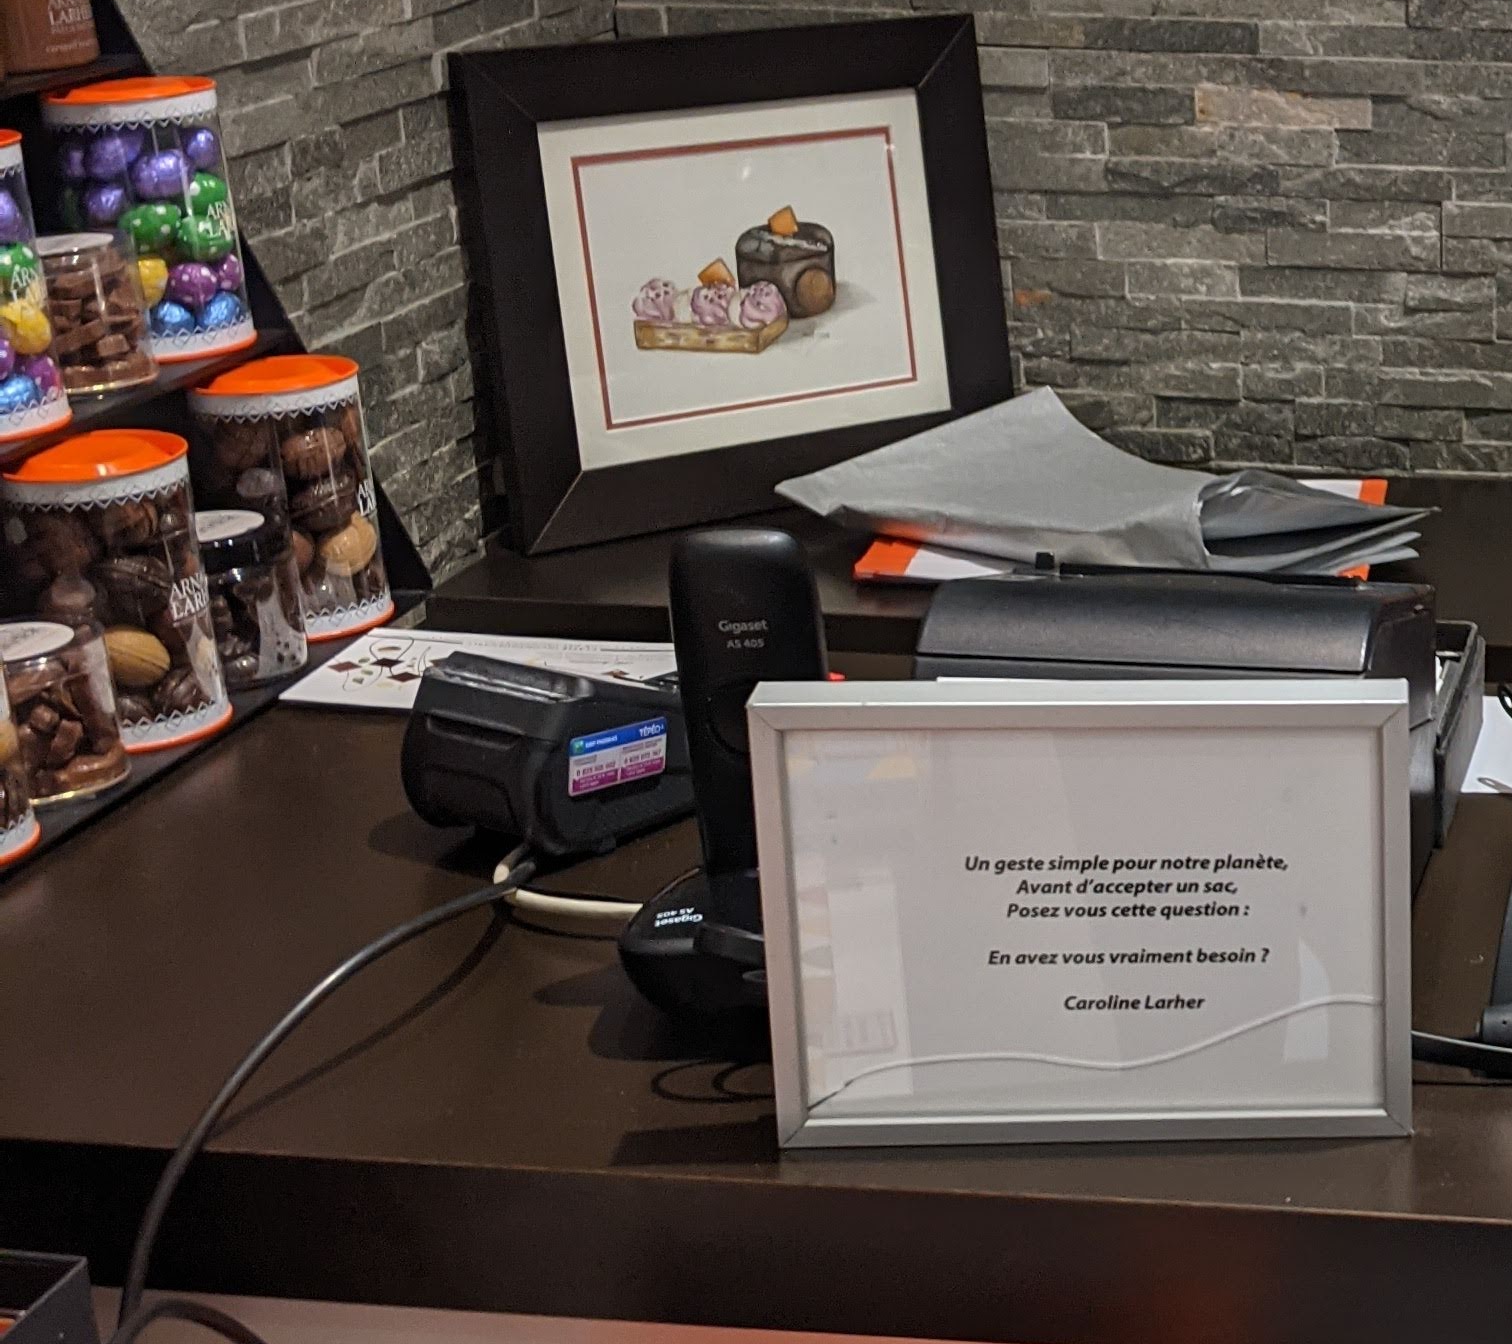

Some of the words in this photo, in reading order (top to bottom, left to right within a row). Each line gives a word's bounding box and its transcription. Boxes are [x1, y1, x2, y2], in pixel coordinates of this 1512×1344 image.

[718, 619, 769, 634] Gigaset
[965, 856, 989, 871] Un
[994, 857, 1044, 874] geste
[1048, 855, 1109, 874] simple
[1112, 858, 1157, 873] pour
[1160, 857, 1210, 871] notre
[1213, 854, 1288, 873] planète,
[1016, 880, 1073, 895] Avant
[1176, 882, 1199, 894] un
[1203, 881, 1238, 895] sac,
[654, 913, 703, 927] Gigaset
[1007, 903, 1060, 918] Posez
[1064, 906, 1107, 918] vous
[1111, 903, 1156, 918] cette
[1160, 903, 1240, 921] question
[988, 950, 1011, 965] En
[1015, 953, 1058, 965] avez
[1062, 952, 1105, 965] vous
[1109, 948, 1193, 964] vraiment
[1196, 948, 1256, 964] besoin
[1261, 947, 1270, 963] ?
[1064, 995, 1141, 1011] Caroline
[1144, 995, 1205, 1011] Larher
